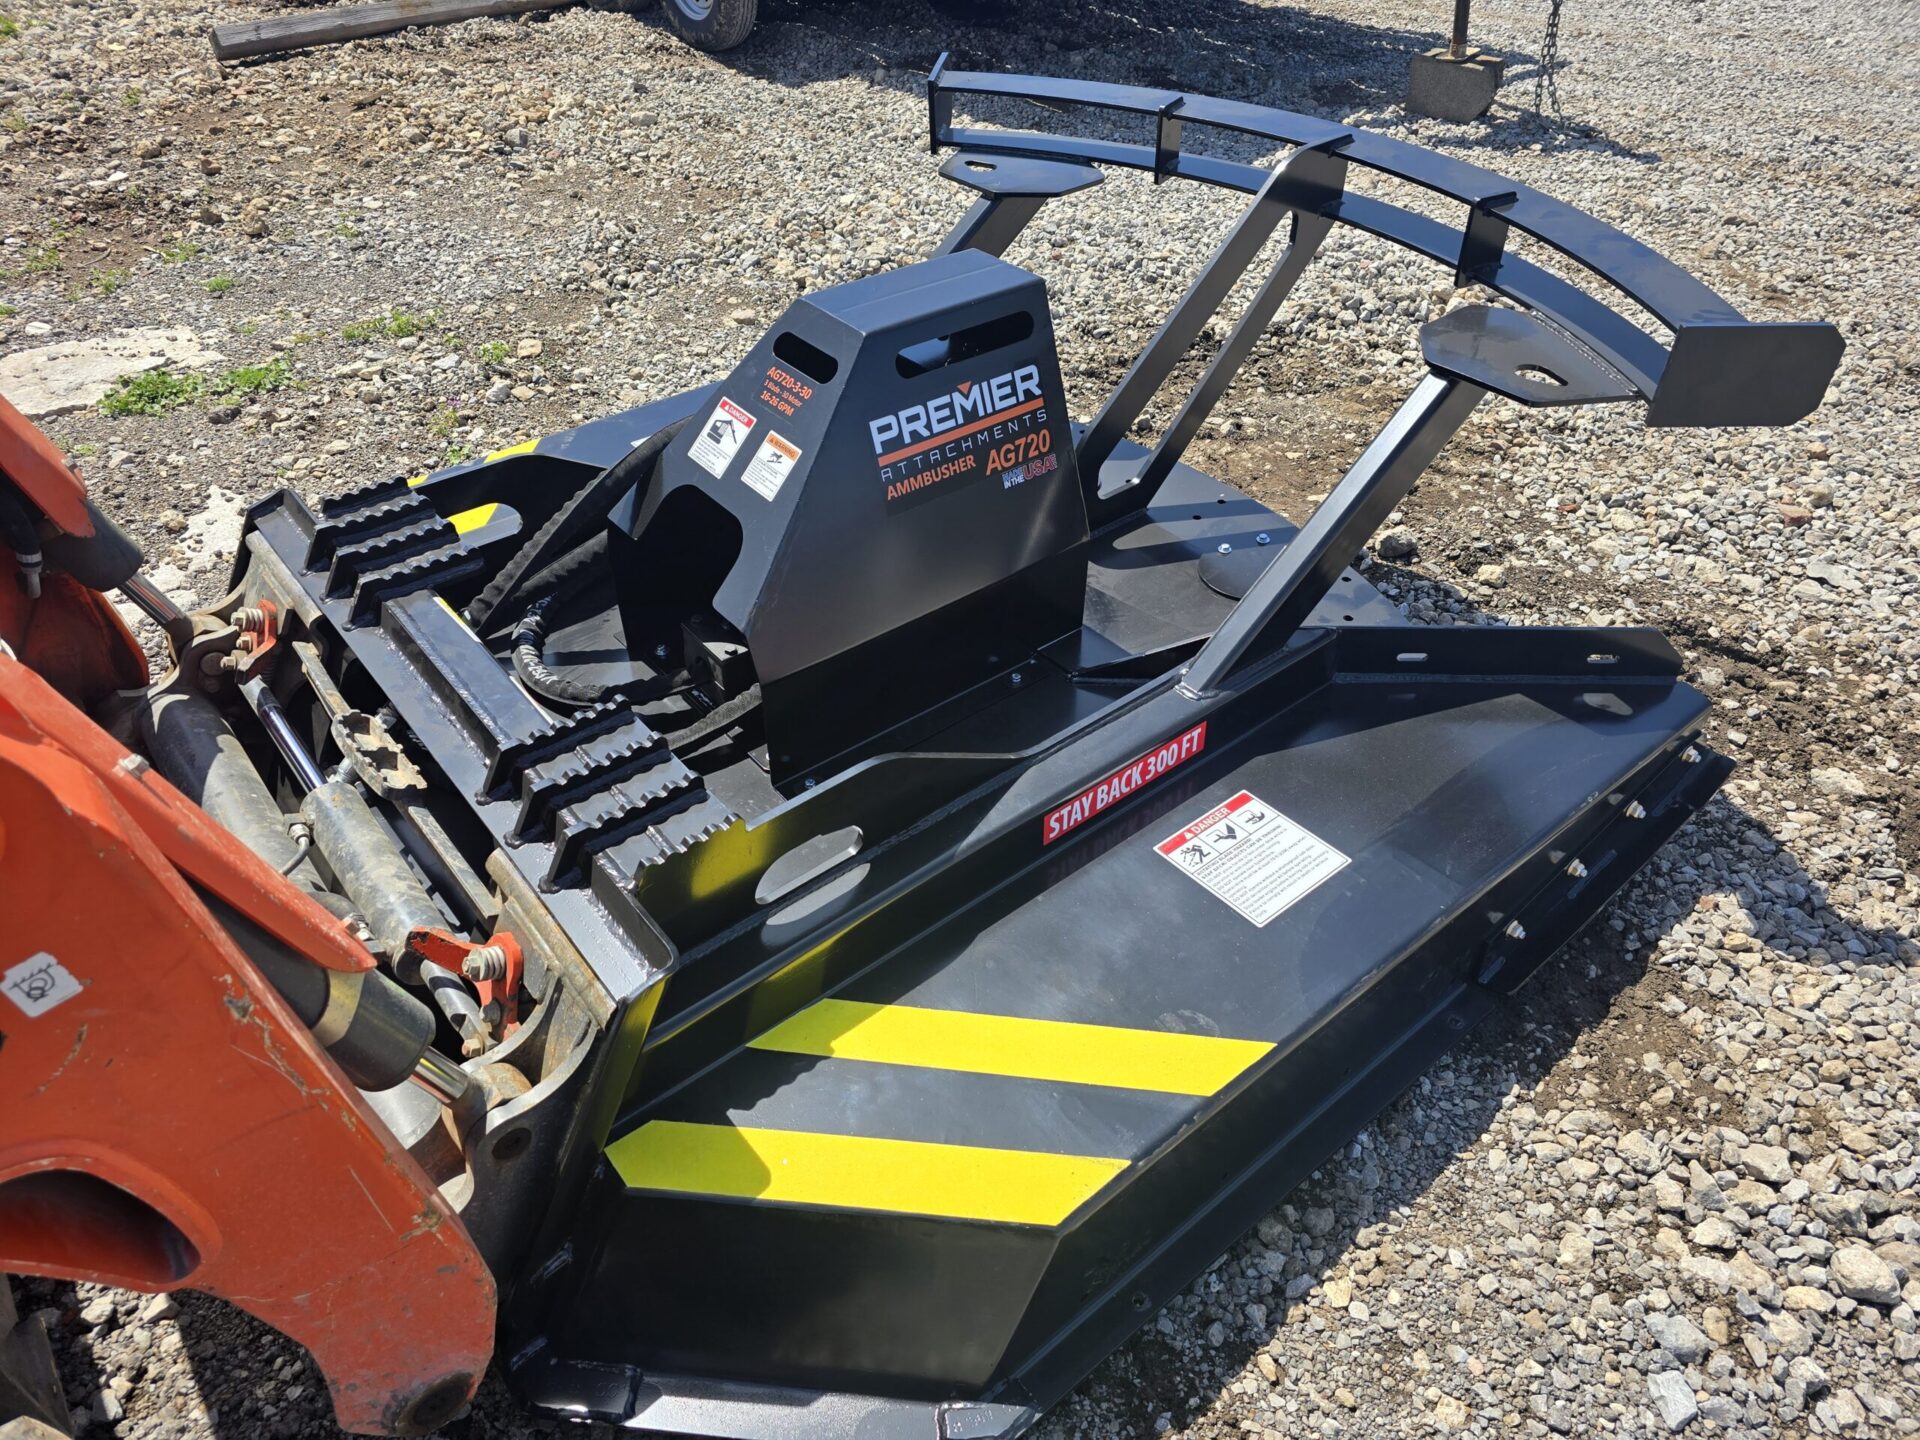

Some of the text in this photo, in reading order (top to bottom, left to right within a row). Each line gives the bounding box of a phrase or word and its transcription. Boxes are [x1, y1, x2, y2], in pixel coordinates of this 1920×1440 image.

[767, 367, 812, 399] AG720-3-30
[728, 406, 749, 424] DANGER
[778, 402, 794, 416] GPM
[869, 364, 1042, 454] PREMIER
[774, 437, 796, 457] WARNING
[881, 409, 1047, 482] ATTACHMENTS
[986, 429, 1050, 476] AG720
[887, 455, 976, 500] AMMBUSHER
[1003, 479, 1011, 489] IN
[1010, 475, 1025, 486] THE
[1049, 728, 1202, 838] STAY BACK 300 FT
[1191, 807, 1232, 834] DANGER
